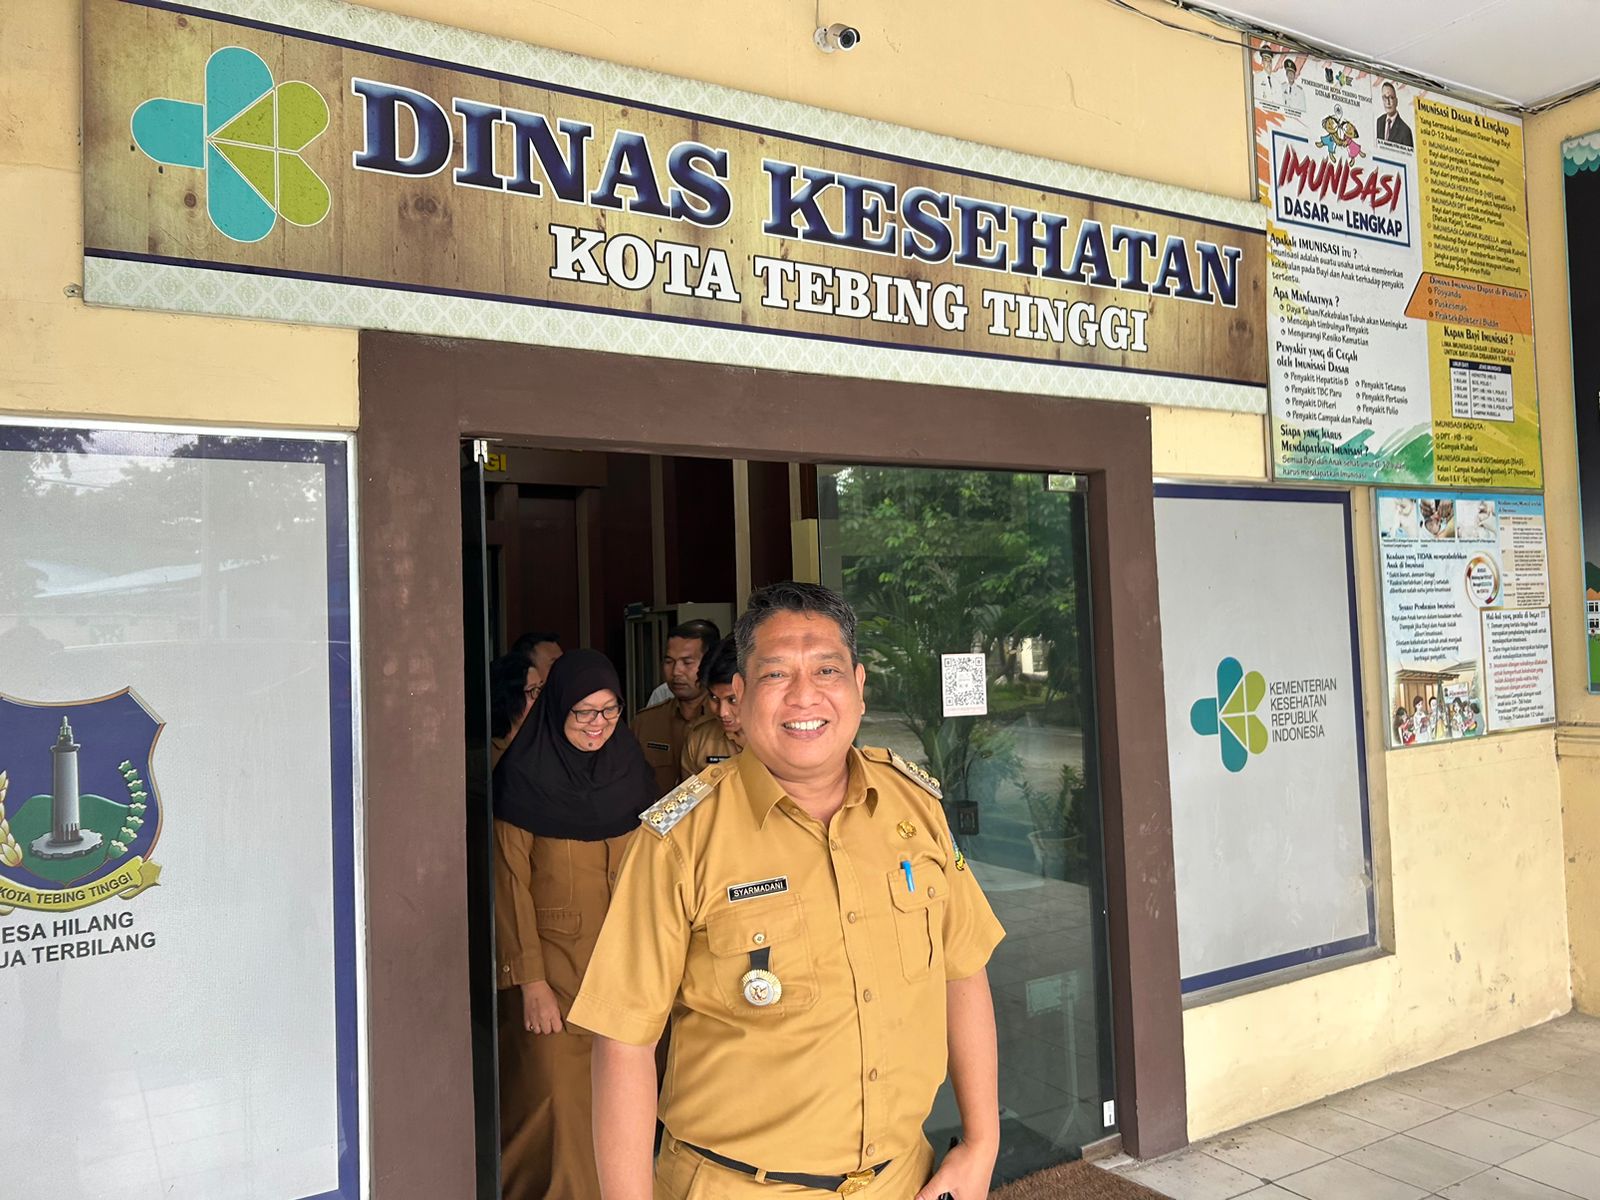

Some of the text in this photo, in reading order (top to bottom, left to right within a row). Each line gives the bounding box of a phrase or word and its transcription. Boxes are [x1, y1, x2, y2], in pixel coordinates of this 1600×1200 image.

[1278, 144, 1402, 214] IMUNISASI
[352, 77, 1241, 308] DINAS KESEHATAN
[1284, 197, 1402, 237] DASAR DAN LENGKAP
[1299, 238, 1340, 255] IMUNISASI
[549, 224, 1148, 352] KOTA TEBING TINGGI
[1290, 371, 1315, 383] Penyakit
[1316, 374, 1345, 386] Hepatitis
[1361, 379, 1406, 392] Penyakit Tetanus
[1291, 384, 1342, 398] Penyakit TBC Paru
[1292, 397, 1337, 409] Penyakit Difteri
[1269, 678, 1337, 695] KEMENTERIAN
[1270, 694, 1327, 711] KESEHATAN
[1271, 710, 1318, 727] REPUBLIK
[1272, 725, 1325, 743] INDONESIA
[0, 872, 133, 904] KOTA TEBING TINGGI
[733, 881, 784, 899] SYARMADANI
[2, 911, 134, 944] ESA HILANG
[32, 931, 156, 963] TERBILANG
